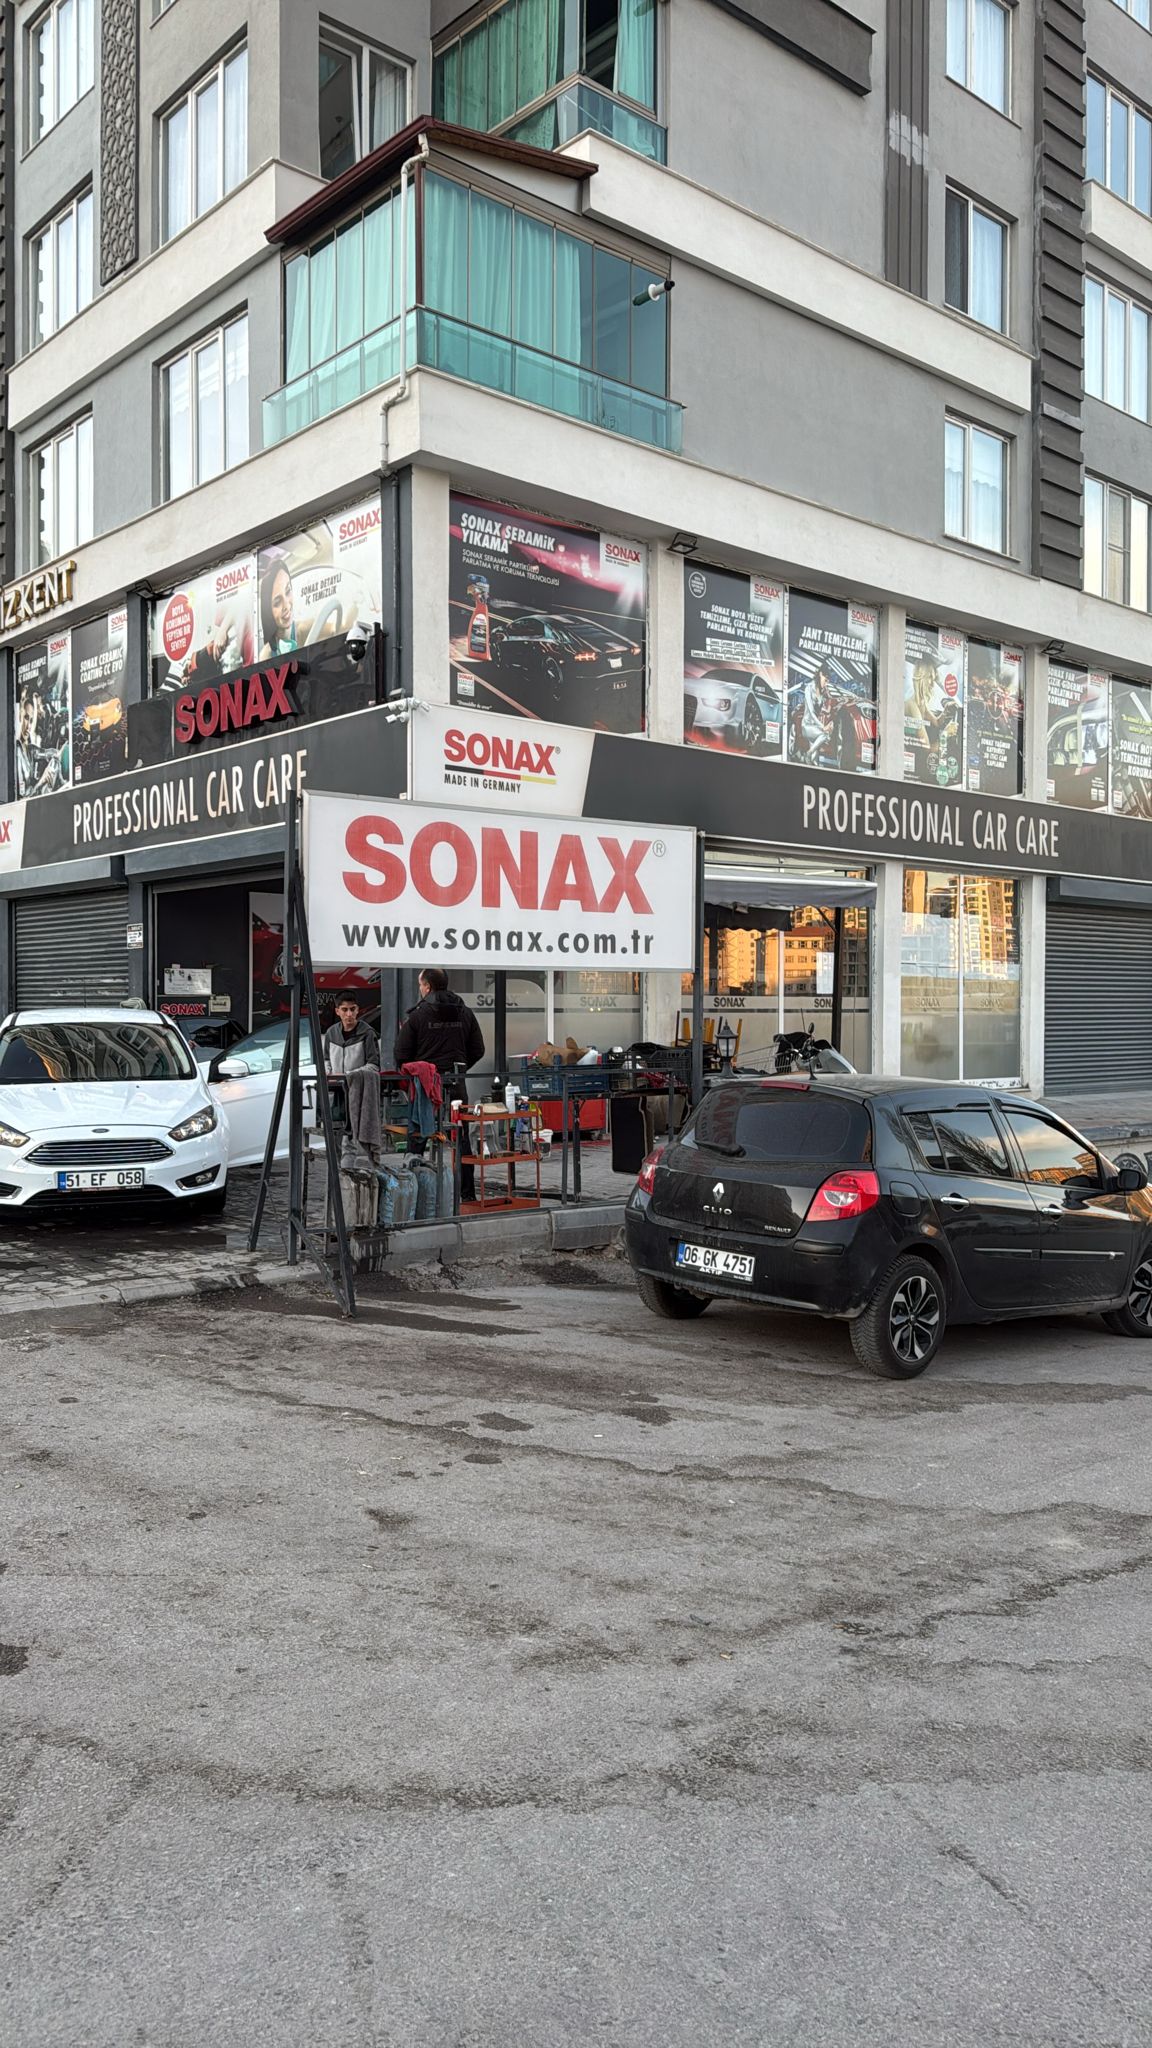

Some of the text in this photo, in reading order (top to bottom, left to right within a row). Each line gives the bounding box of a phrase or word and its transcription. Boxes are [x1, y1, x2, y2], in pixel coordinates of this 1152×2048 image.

[339, 508, 382, 540] SONAX
[460, 513, 502, 538] SONAX
[462, 548, 483, 560] SONAX
[605, 543, 641, 563] SONAX
[462, 556, 491, 569] PARLATMA
[501, 566, 526, 577] KORUMA
[216, 566, 249, 592] SONAX
[301, 581, 319, 598] SONAX
[754, 584, 780, 598] SONAX
[111, 613, 128, 627] SONA
[711, 604, 730, 616] SONAX
[731, 609, 746, 620] BOYA
[851, 610, 876, 623] SONAX
[706, 621, 768, 642] PARLATMA VE KORUMA
[801, 626, 823, 641] JANT
[50, 637, 68, 652] SONAX
[941, 634, 961, 647] SONAX
[799, 638, 869, 663] PARLATMA VE KORUMA
[1004, 651, 1022, 663] SONAX
[80, 648, 123, 673] SONAX CERAMIC
[80, 667, 103, 684] COATING
[112, 659, 123, 672] EVO
[175, 662, 293, 744] SONAX
[1120, 739, 1139, 753] SONAX
[444, 773, 521, 794] MADE IN GERMANY
[73, 776, 199, 845] PROFESSIONAL
[206, 765, 244, 819] CAR
[803, 784, 1059, 857] PROFESSIONAL CAR CARE
[342, 923, 654, 956] www.sonax.com.tr
[161, 1003, 205, 1015] SONAX
[580, 996, 617, 1008] SONAX
[713, 996, 745, 1008] SONAX
[66, 1174, 80, 1187] 51
[91, 1173, 107, 1186] EF
[117, 1171, 142, 1185] 058
[702, 1205, 732, 1215] CLIO
[764, 1225, 792, 1234] RENAULT
[683, 1246, 698, 1263] 06
[703, 1250, 719, 1268] GK
[723, 1253, 754, 1275] 4751
